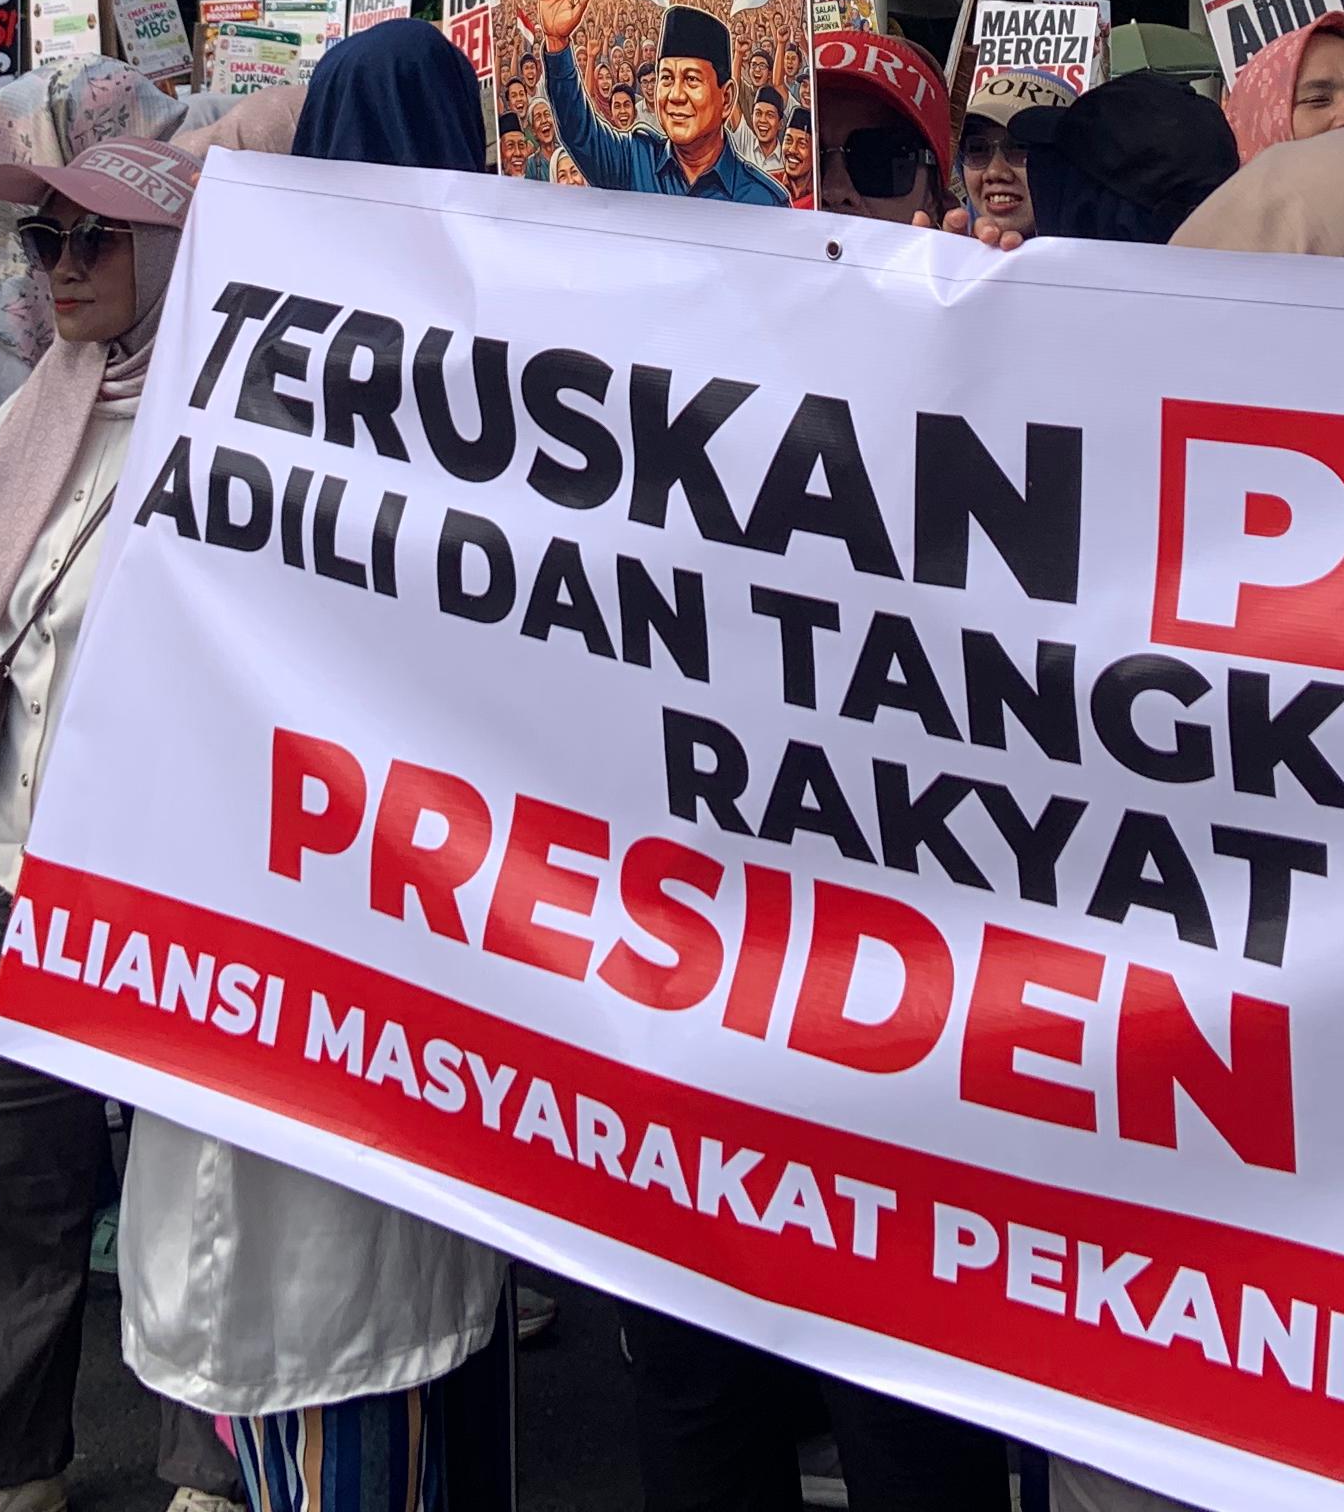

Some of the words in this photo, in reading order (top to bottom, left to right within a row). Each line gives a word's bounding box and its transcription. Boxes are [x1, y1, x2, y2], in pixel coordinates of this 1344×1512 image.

[135, 19, 171, 39] MBG
[981, 9, 1077, 37] MAKAN
[230, 62, 287, 76] EMAK-EMAK
[978, 36, 1089, 66] BERGIZI
[234, 72, 278, 85] DUKUNG
[83, 152, 181, 206] SPORT
[188, 281, 1083, 606] TERUSKAN
[133, 434, 408, 599] ADILI
[437, 508, 709, 683] DAN
[662, 706, 1327, 968] RAKYAT
[267, 726, 1297, 1174] PRESIDEN
[0, 896, 282, 1047] ALIANSI
[304, 991, 897, 1261] MASYARAKAT
